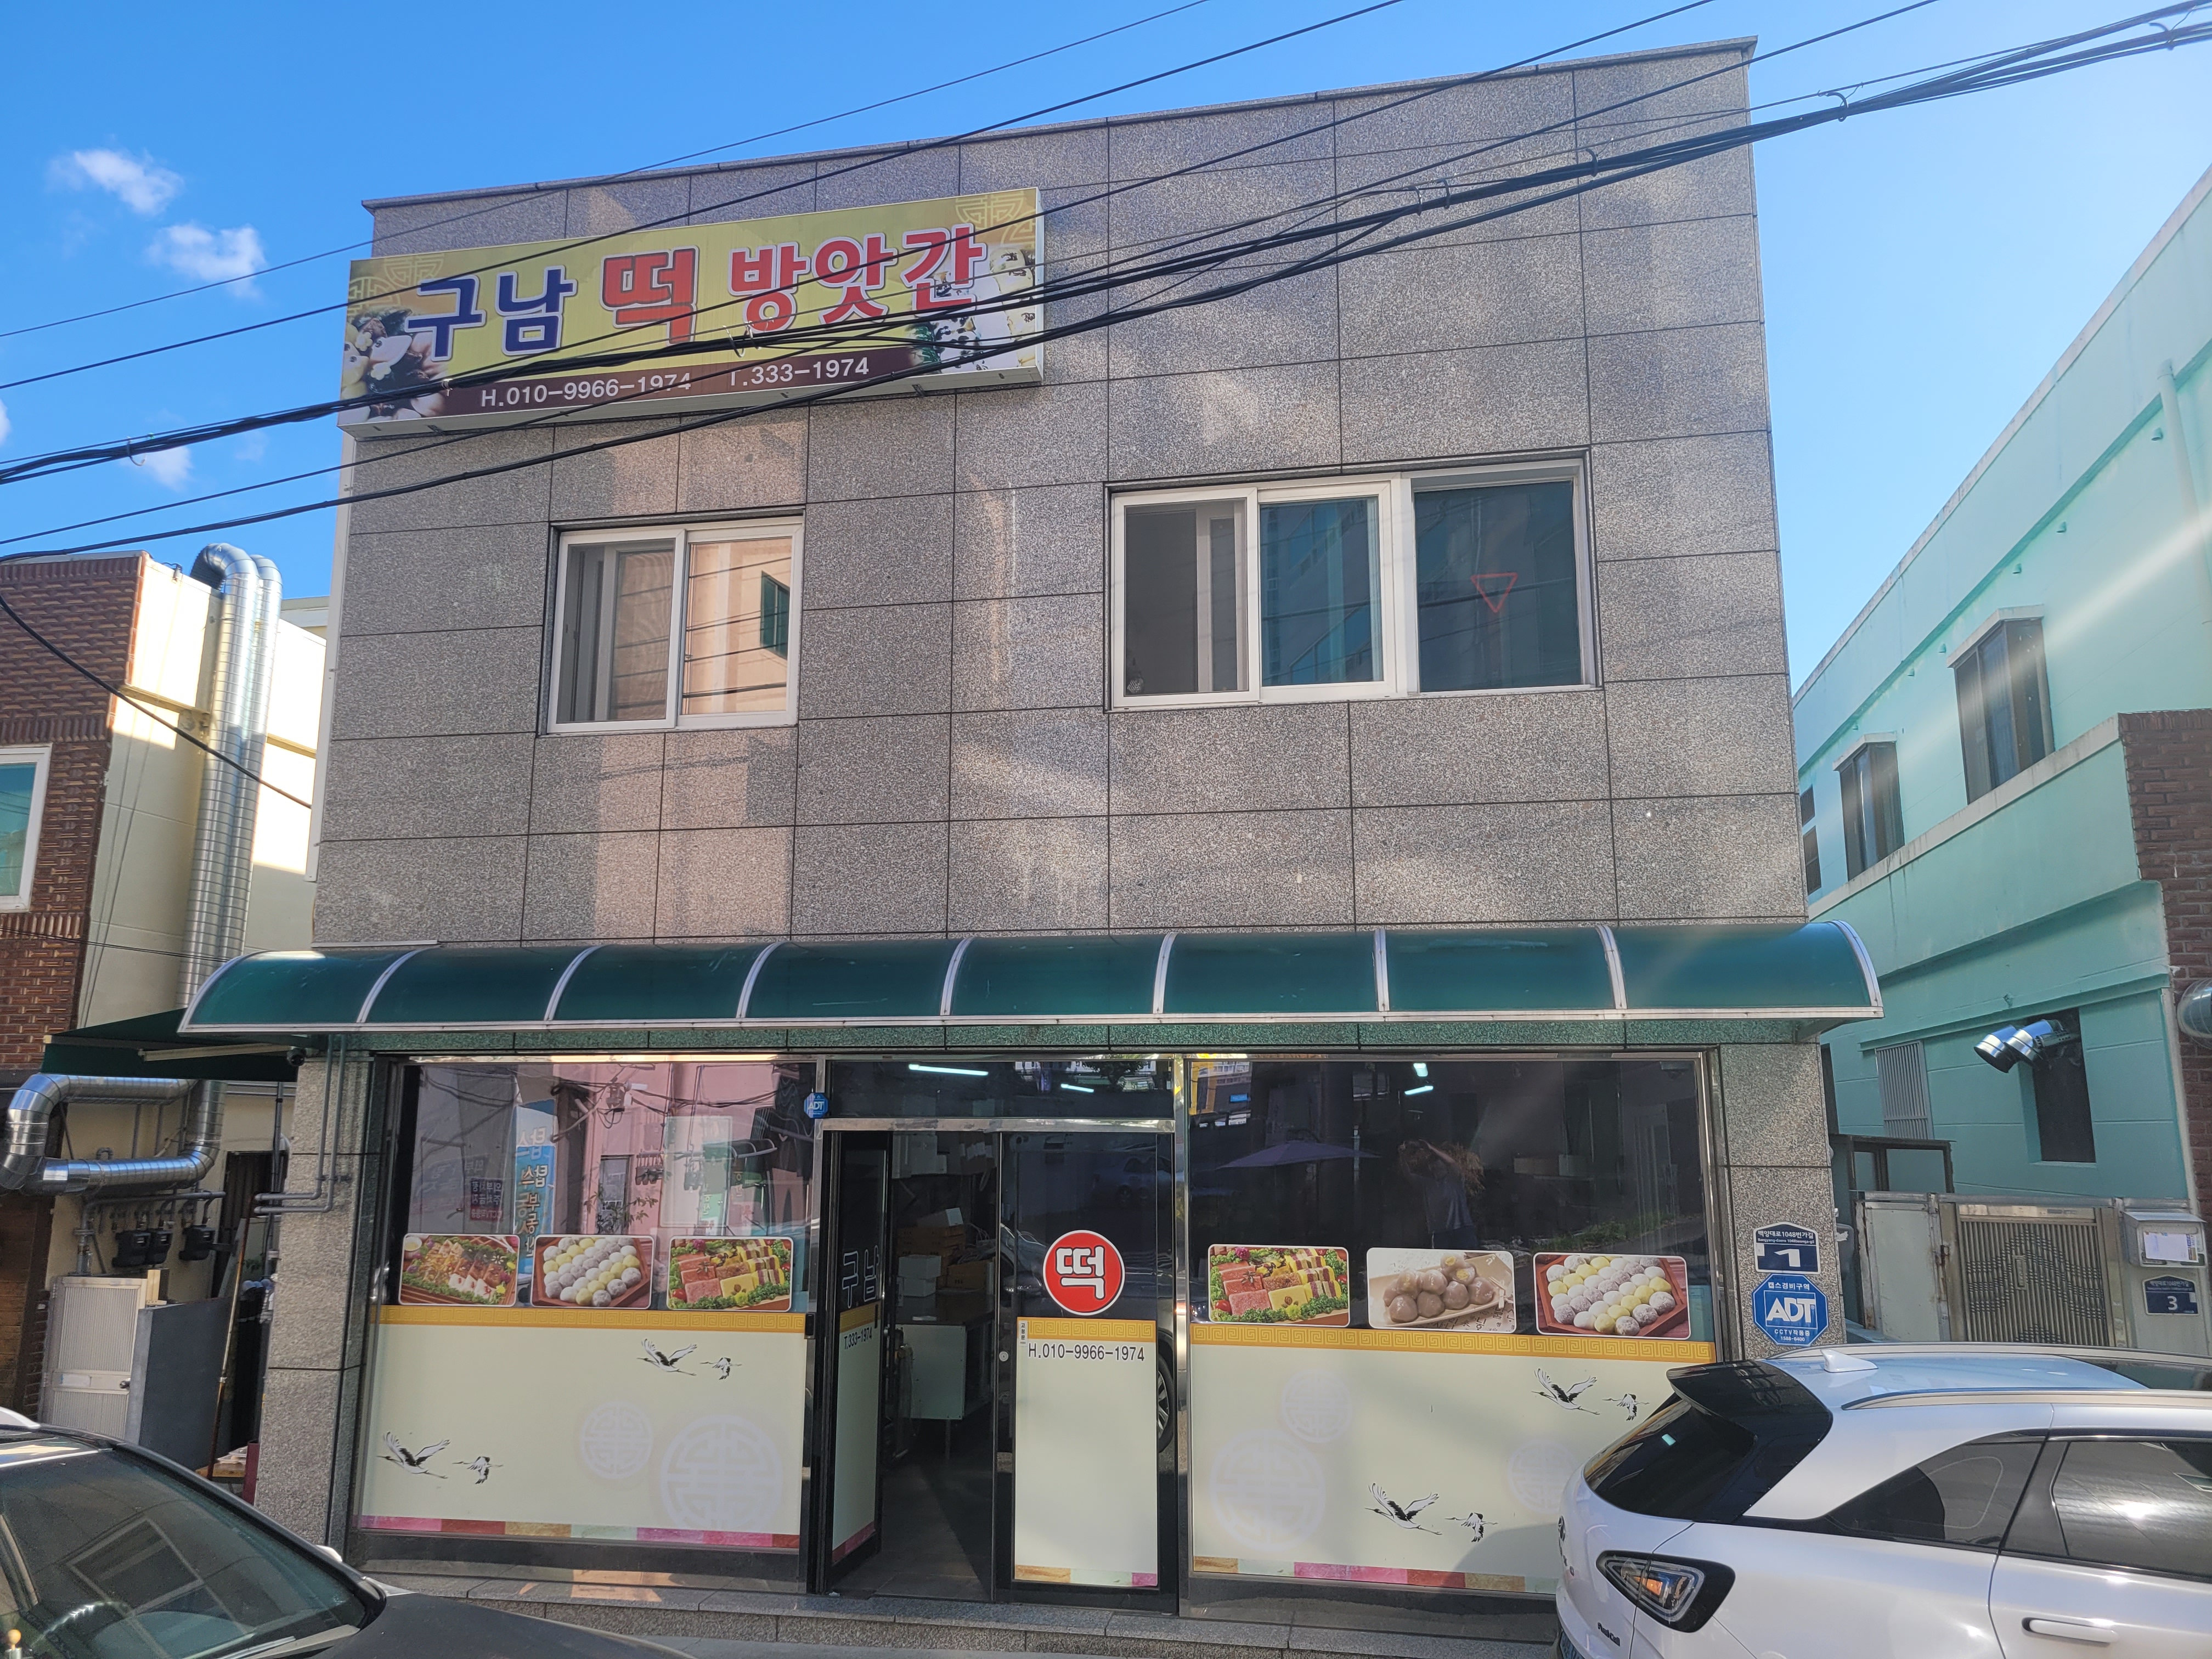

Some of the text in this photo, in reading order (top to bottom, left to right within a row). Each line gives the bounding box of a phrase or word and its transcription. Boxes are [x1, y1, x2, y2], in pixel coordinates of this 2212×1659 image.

[405, 223, 987, 361] 구남 떡 방앗간
[481, 373, 691, 407] H.010-9966-1974
[808, 1101, 825, 1110] ADT
[1758, 1230, 1814, 1239] 백양대로1048번가길
[1774, 1249, 1801, 1267] 1
[842, 1245, 879, 1308] 구남
[1056, 1246, 1105, 1300] 떡
[1768, 1282, 1810, 1291] 캡스경비구역
[1767, 1297, 1816, 1323] ADT
[2167, 1295, 2178, 1311] 3
[844, 1327, 872, 1350] T.333-1974
[1028, 1342, 1145, 1362] H.010-9966-1974
